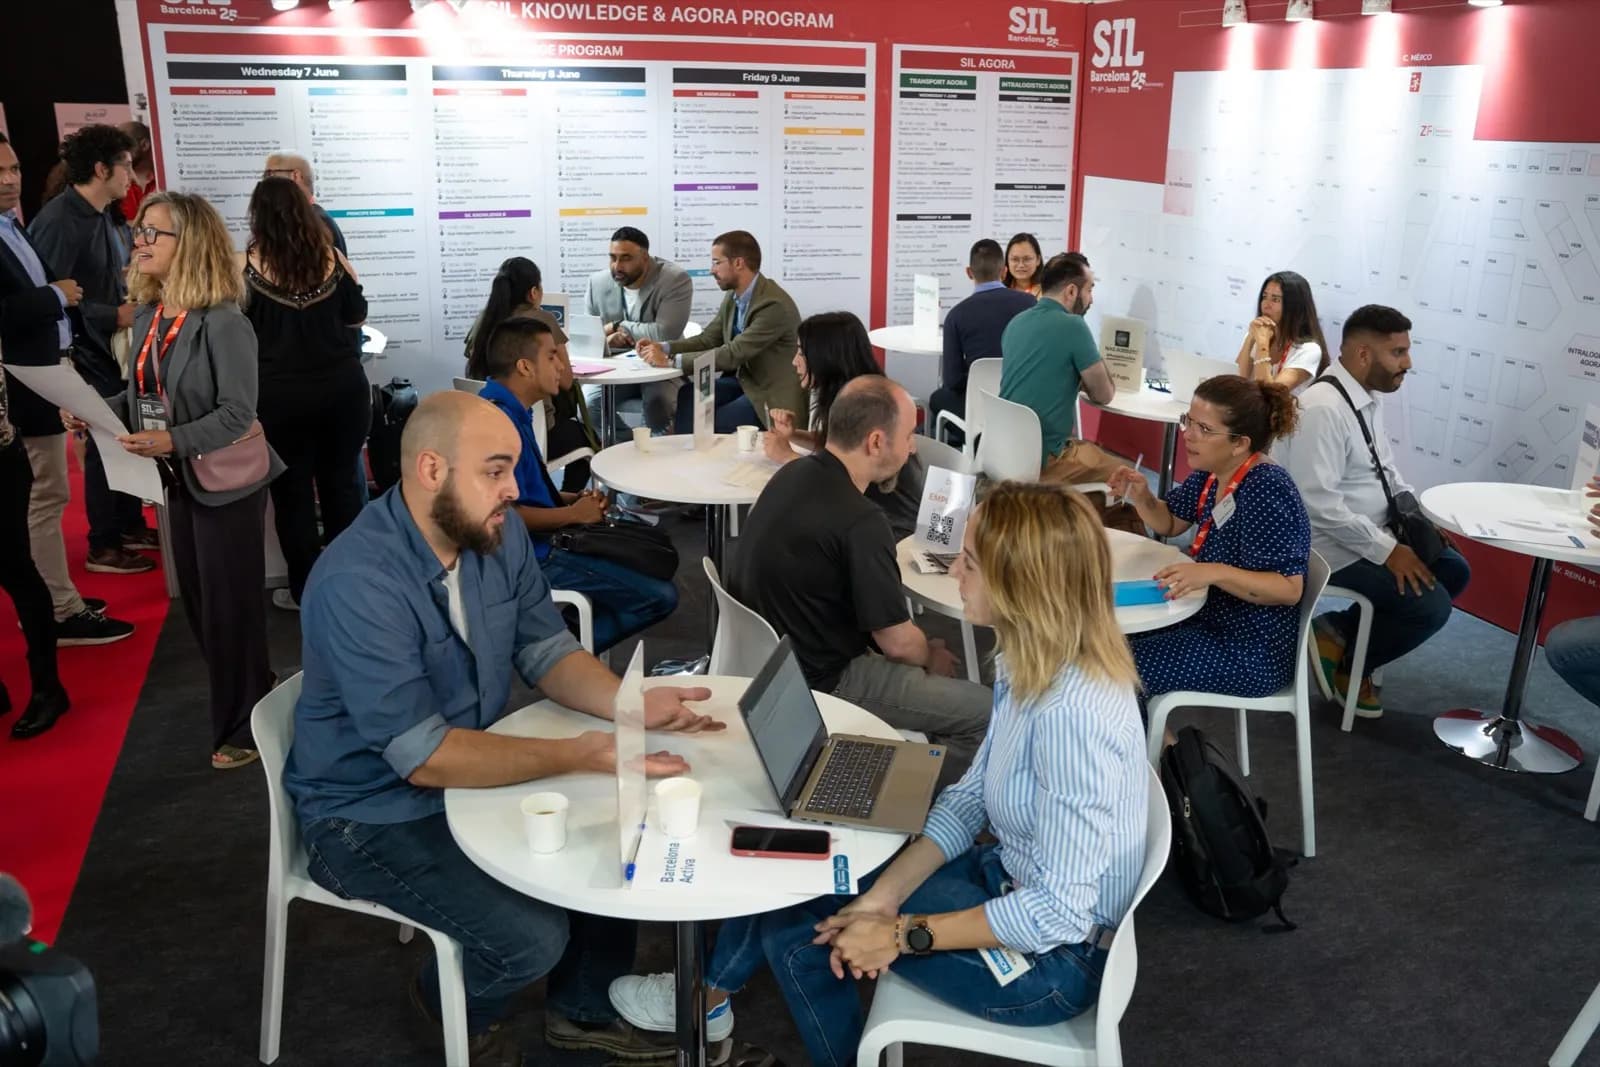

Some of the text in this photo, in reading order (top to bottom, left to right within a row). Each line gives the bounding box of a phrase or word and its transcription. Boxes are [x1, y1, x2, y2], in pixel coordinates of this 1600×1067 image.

[160, 5, 217, 15] Barcelona
[522, 2, 648, 23] KNOWLEDGE
[652, 7, 666, 23] &
[671, 7, 738, 25] AGORA
[742, 11, 834, 29] PROGRAM
[1008, 6, 1057, 36] SIL
[1008, 34, 1046, 45] Barcelona
[1091, 17, 1144, 68] SIL
[558, 44, 623, 57] PROGRAM
[960, 58, 1016, 70] SIL AGORA
[240, 66, 340, 80] Wednesday 7 June
[501, 68, 547, 80] Thursday
[556, 70, 580, 79] June
[742, 73, 800, 84] Friday 9 June
[1090, 70, 1130, 82] Barcelona
[909, 77, 968, 86] TRANSPORT AGORA
[1001, 81, 1069, 90] INTRALOGISTICS AGORA
[1564, 569, 1586, 584] REINA
[660, 842, 680, 883] Barcelona
[679, 858, 696, 884] Activa
